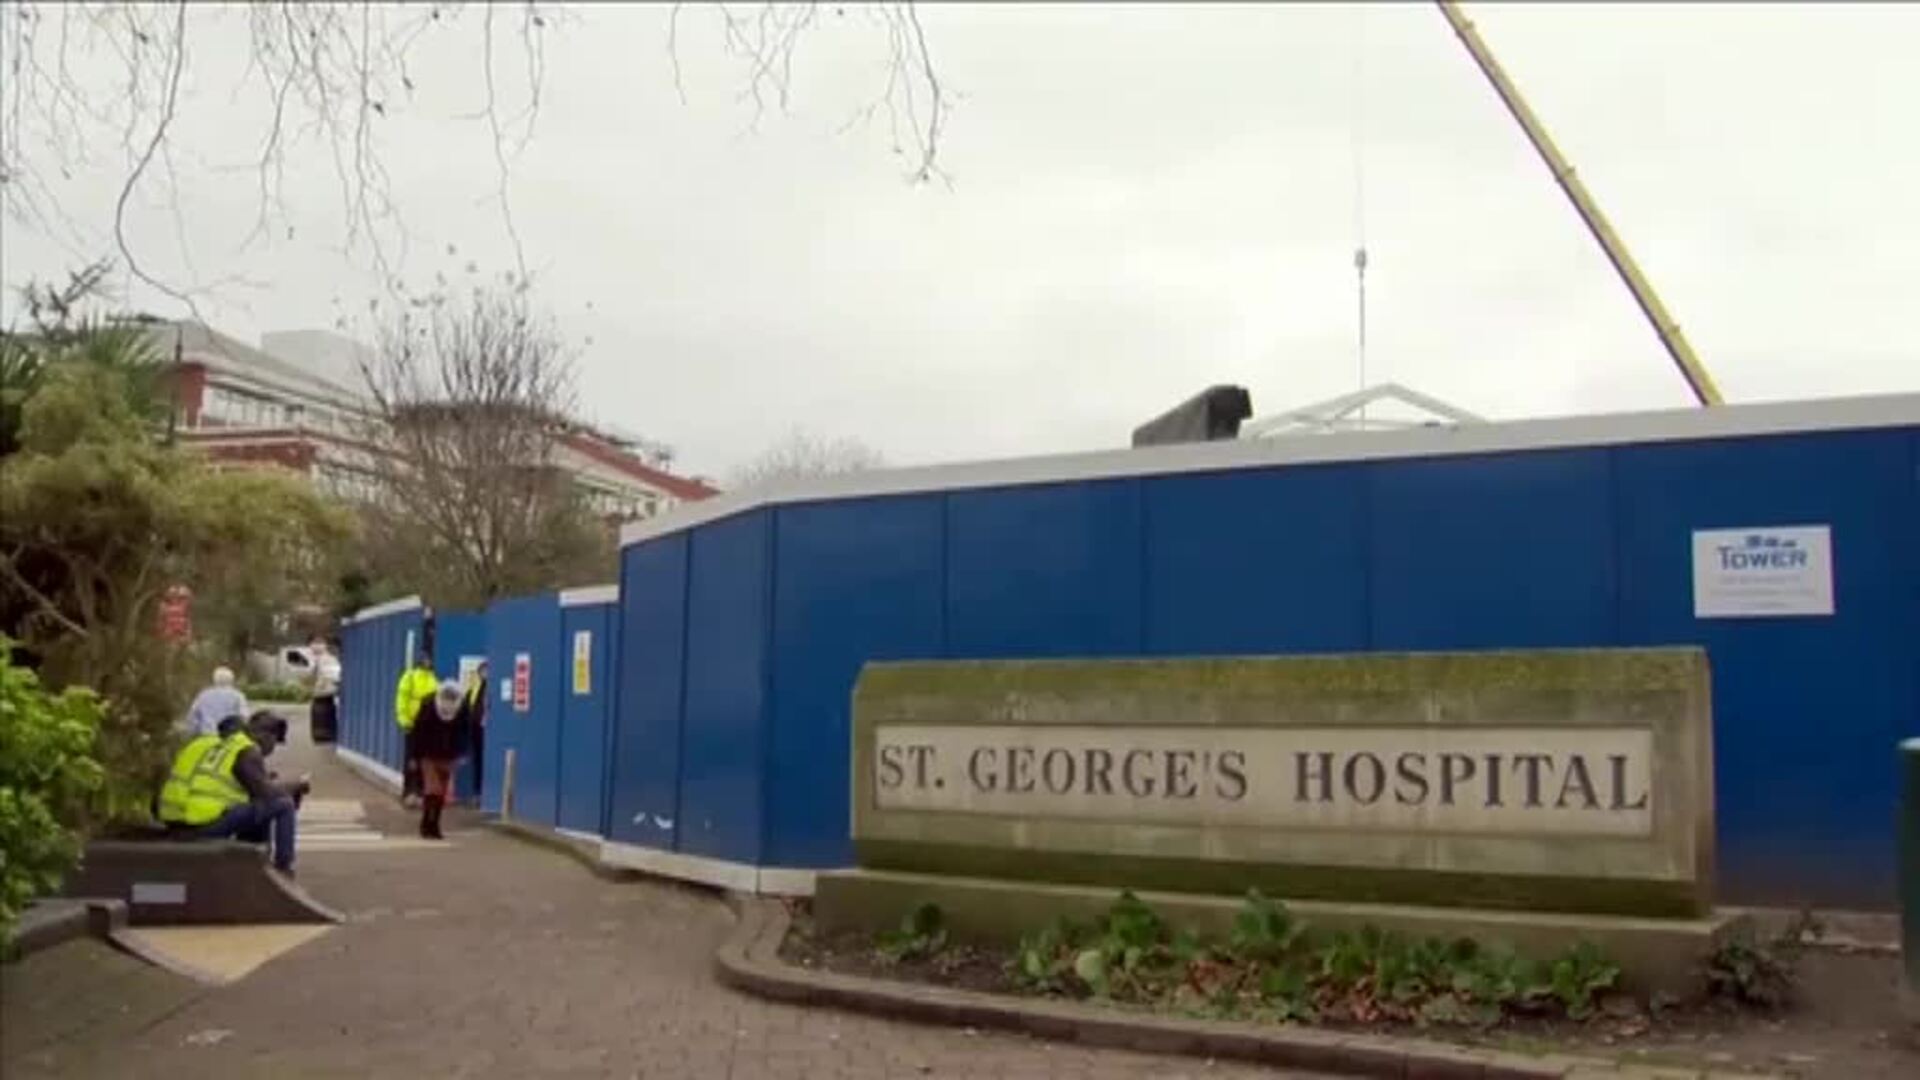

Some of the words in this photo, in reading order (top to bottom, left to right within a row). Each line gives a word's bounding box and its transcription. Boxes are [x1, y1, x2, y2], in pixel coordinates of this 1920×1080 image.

[1717, 545, 1807, 570] TOWER
[879, 744, 945, 790] ST.
[967, 746, 1249, 801] GEORGE'S
[1293, 750, 1649, 811] HOSPITAL
